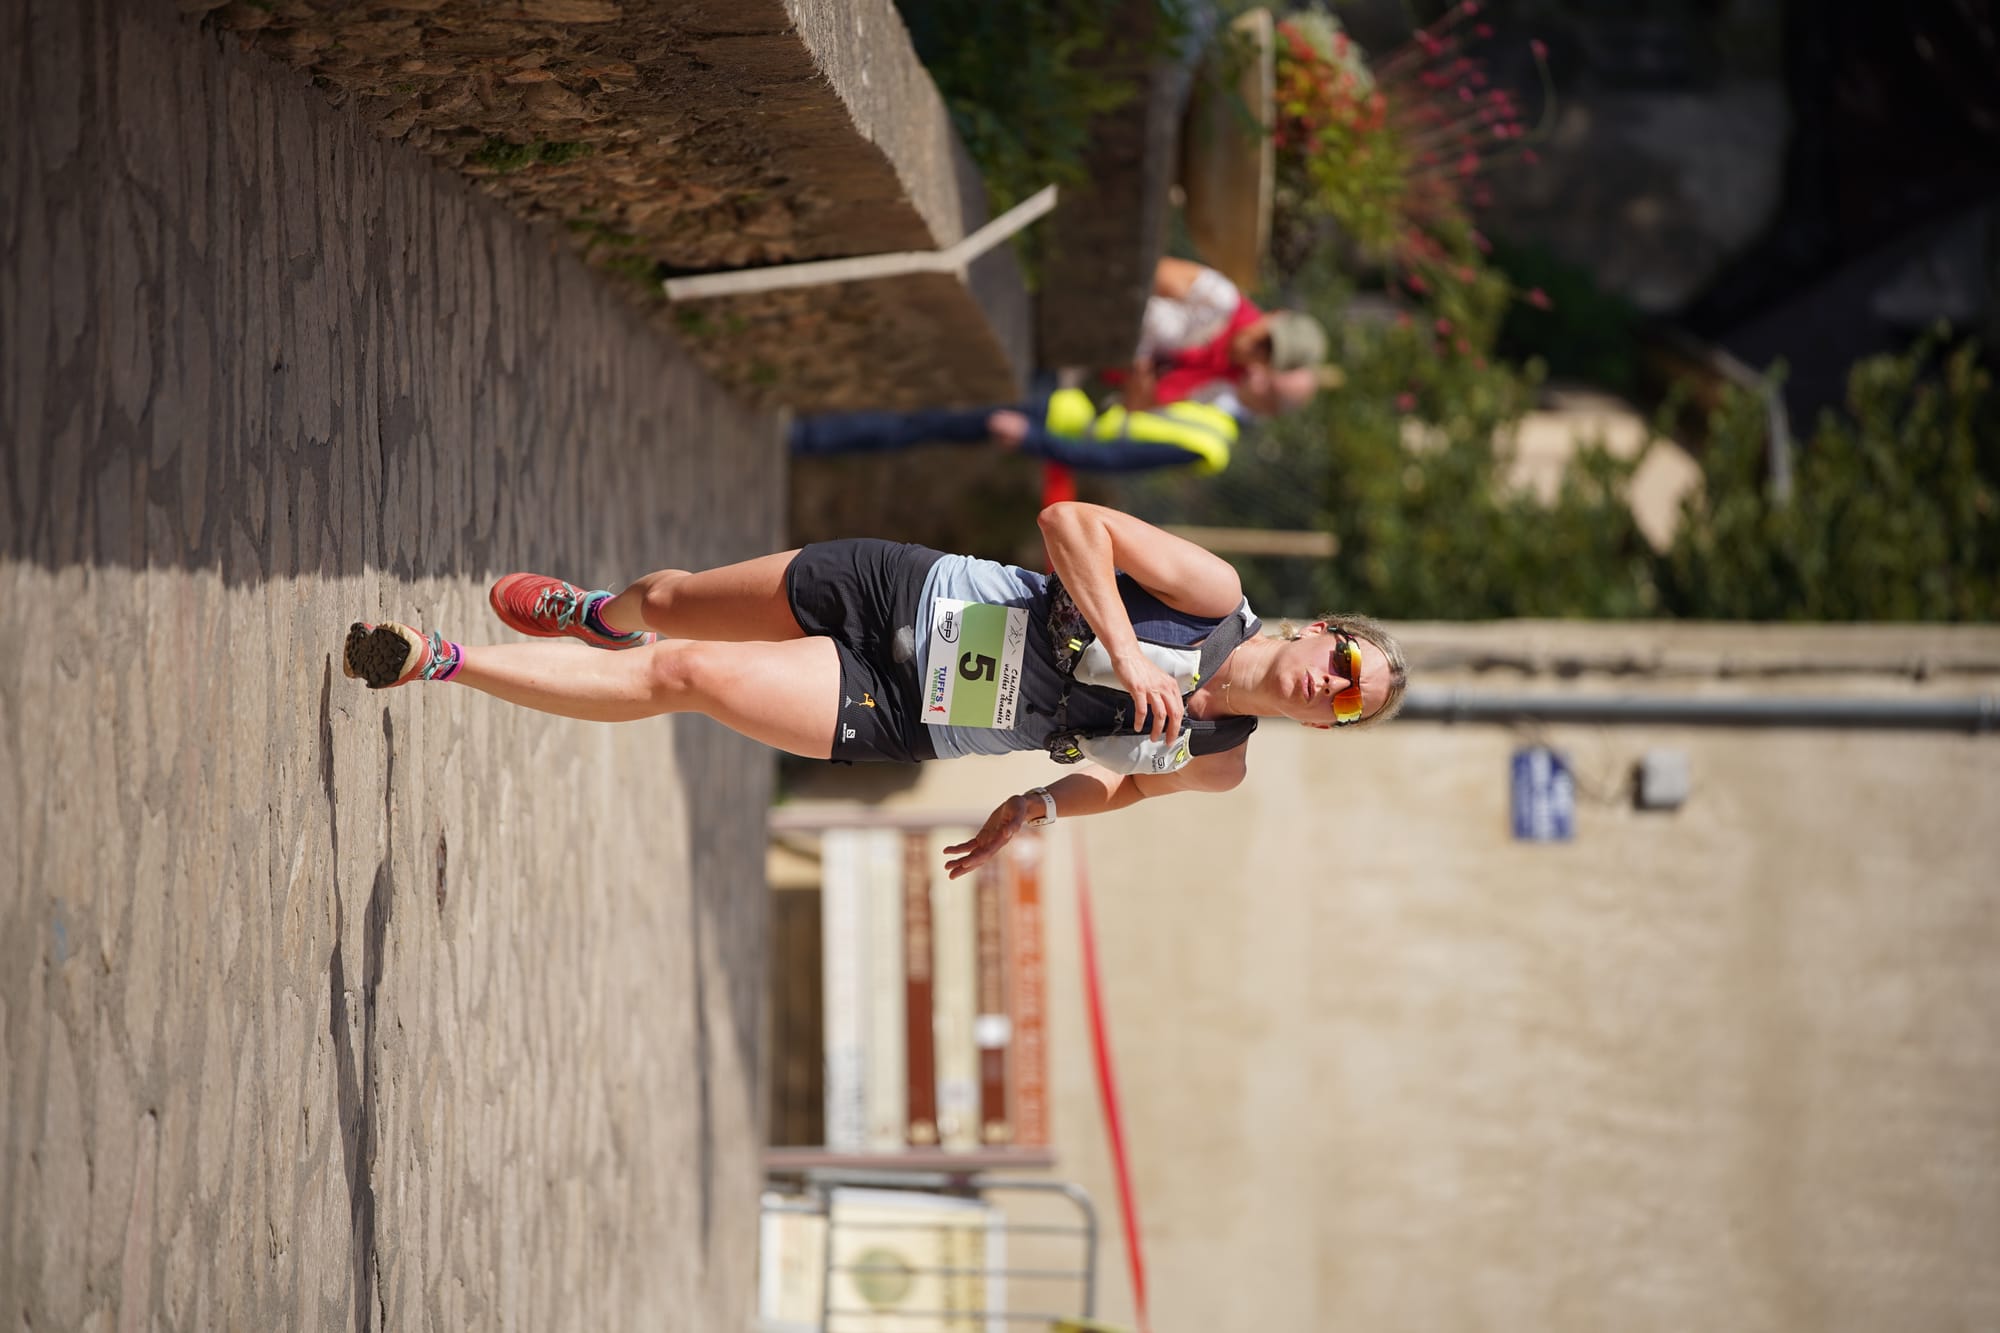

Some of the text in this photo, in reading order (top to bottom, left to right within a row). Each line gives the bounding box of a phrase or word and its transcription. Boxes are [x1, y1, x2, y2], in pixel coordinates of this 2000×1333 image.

[936, 666, 947, 703] TUFF'S
[959, 651, 997, 682] 5
[930, 668, 939, 705] Aventure
[1005, 668, 1018, 722] Challenge des
